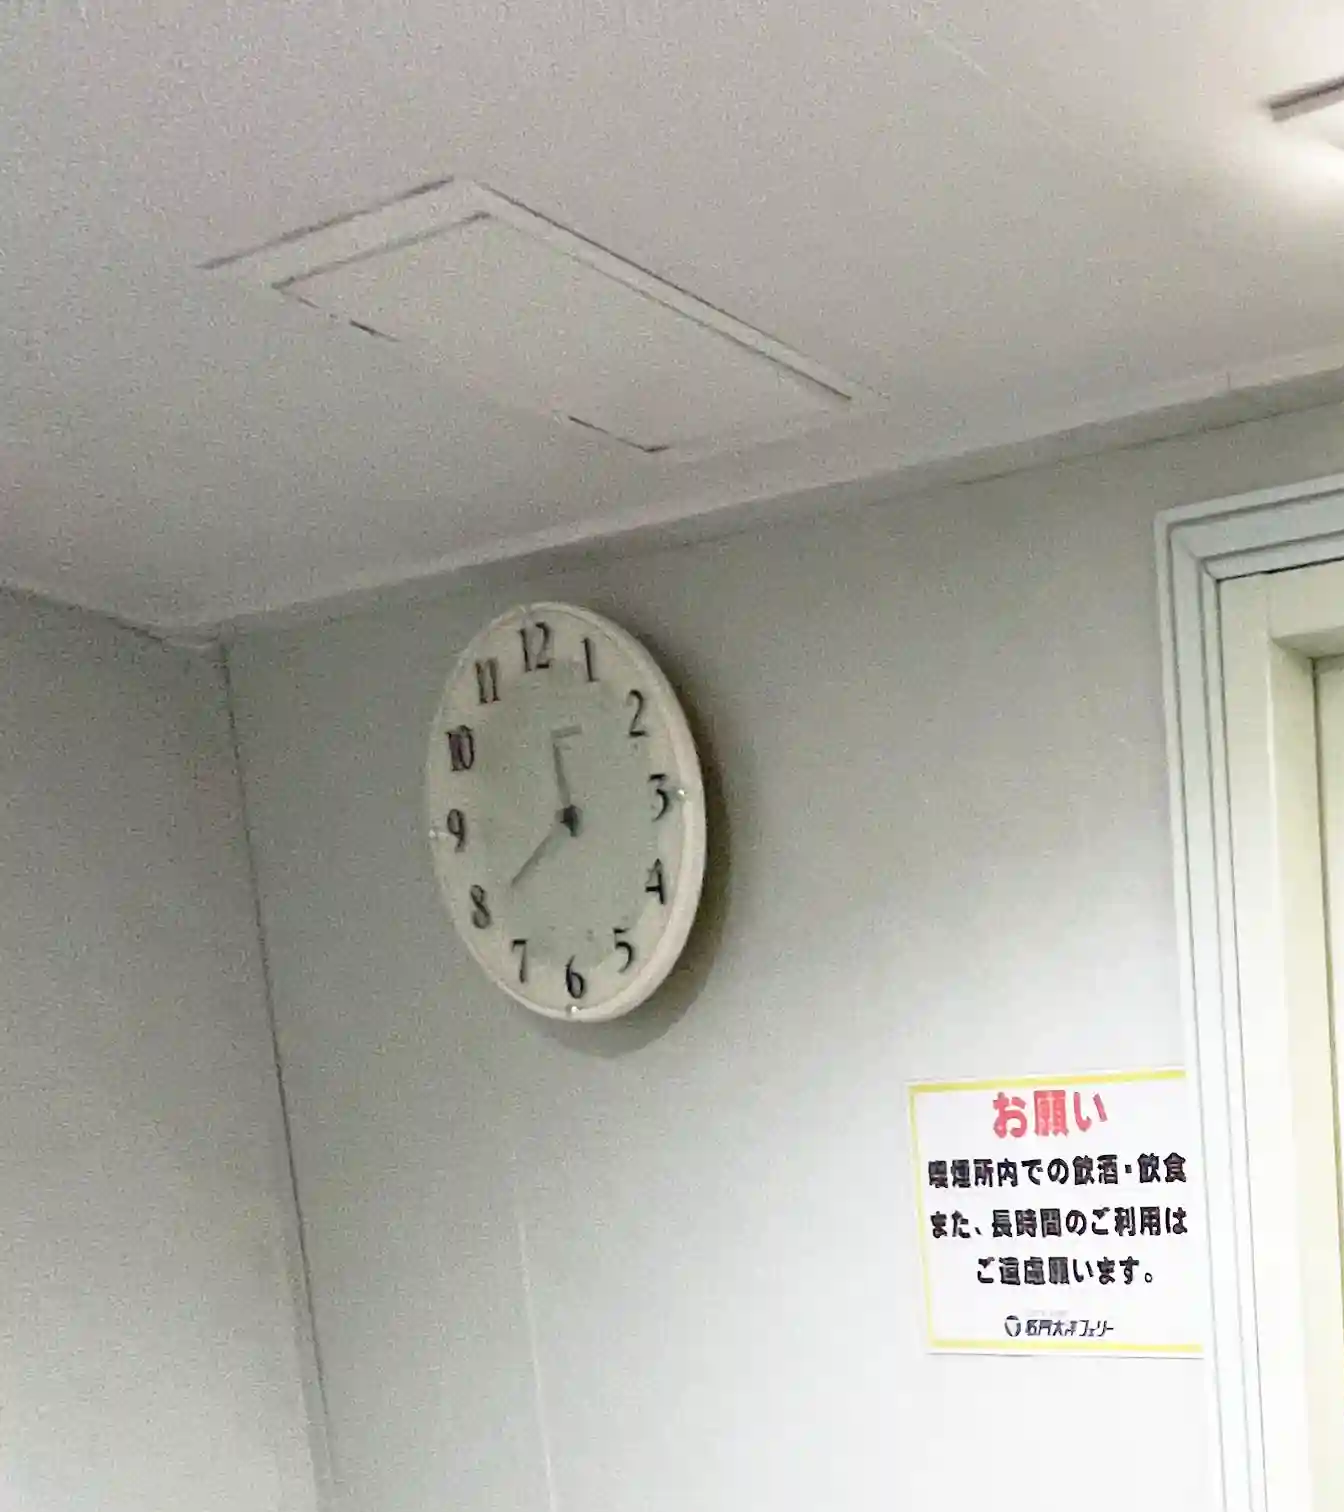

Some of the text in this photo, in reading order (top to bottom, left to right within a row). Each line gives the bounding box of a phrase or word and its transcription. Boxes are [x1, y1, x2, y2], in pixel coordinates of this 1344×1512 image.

[518, 621, 552, 673] 12
[580, 636, 600, 683] 1
[474, 656, 501, 705] 11
[627, 688, 650, 738] 2
[445, 723, 476, 772] 10
[647, 773, 675, 822] 3
[446, 808, 468, 853] 9
[644, 857, 667, 906] 4
[469, 884, 493, 930] 8
[510, 937, 532, 984] 7
[611, 926, 637, 974] 5
[564, 954, 588, 1000] 6
[992, 1089, 1108, 1139] お願い
[930, 1205, 1189, 1239] また、長時間のご利用は
[976, 1255, 1154, 1285] ご遠慮願います。
